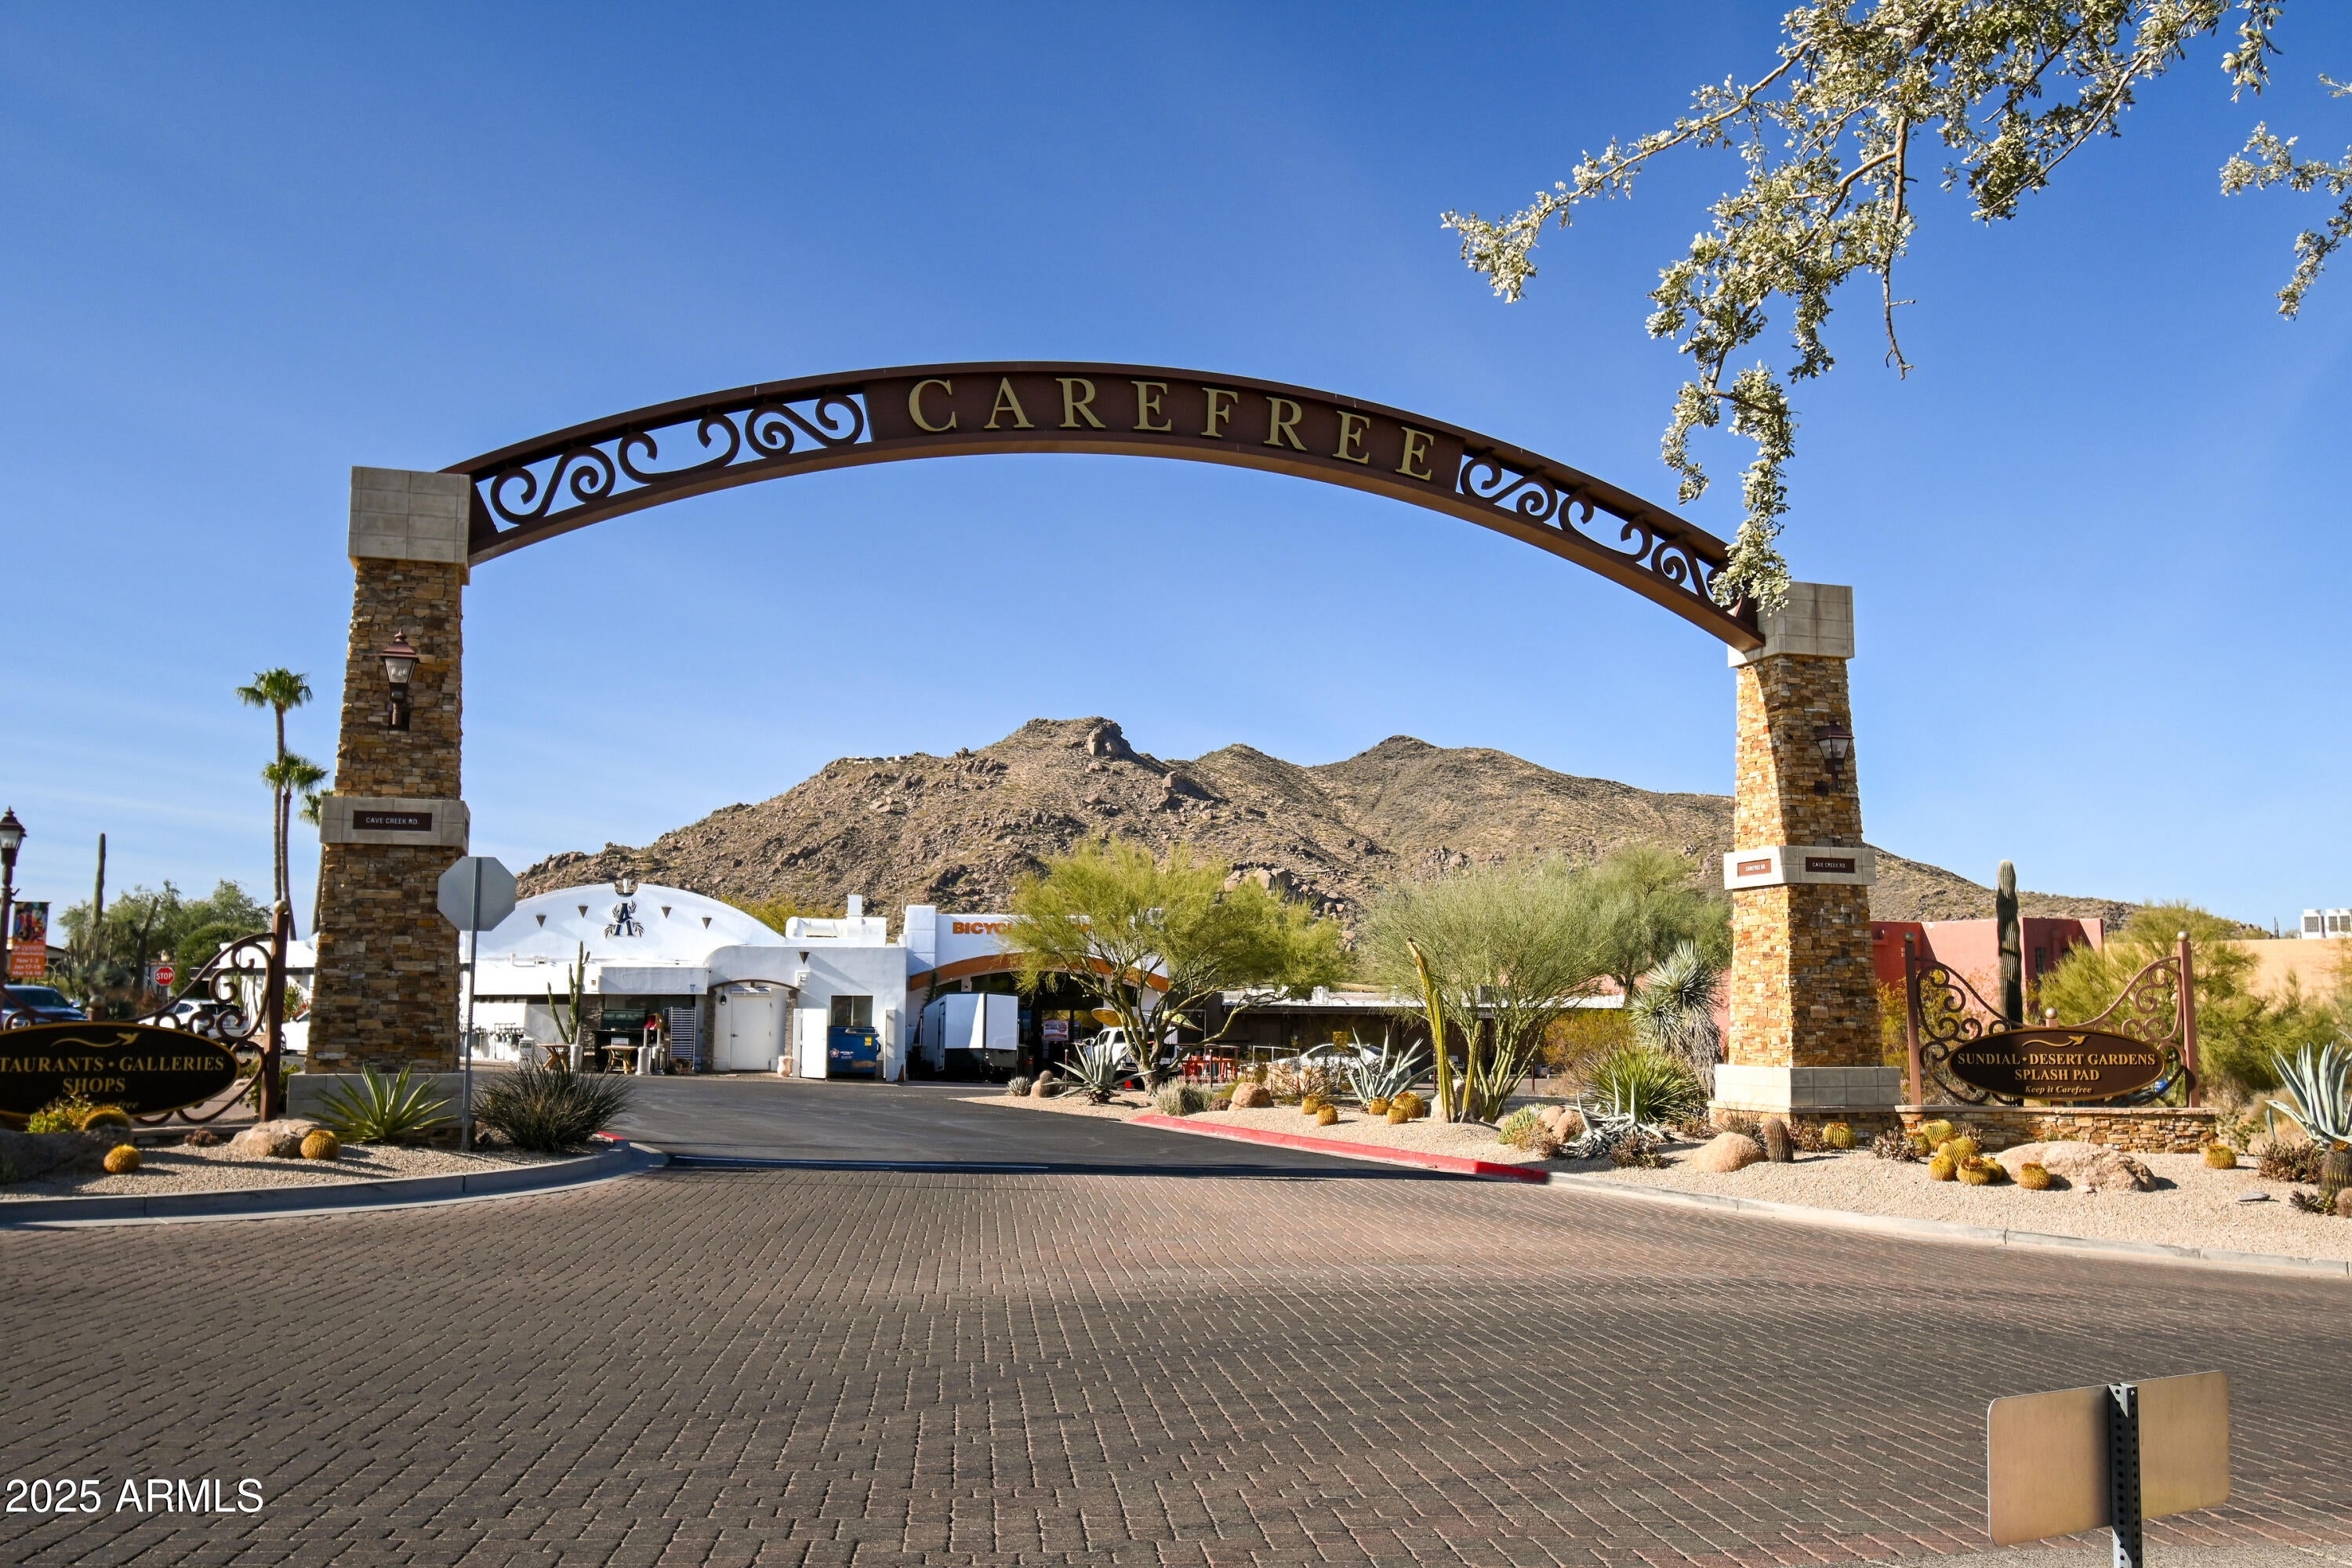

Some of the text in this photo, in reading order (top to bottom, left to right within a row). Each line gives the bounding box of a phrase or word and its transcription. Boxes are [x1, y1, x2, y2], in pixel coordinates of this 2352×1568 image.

[908, 377, 1436, 482] CAREFREE
[119, 1056, 225, 1072] GALLERIES
[1958, 1054, 2156, 1065] SUNDIAL DESERT GARDENS
[2015, 1069, 2100, 1080] SPLASH PAD
[63, 1078, 126, 1093] SHOPS
[2025, 1085, 2045, 1094] Keep
[2056, 1085, 2092, 1095] Carefree
